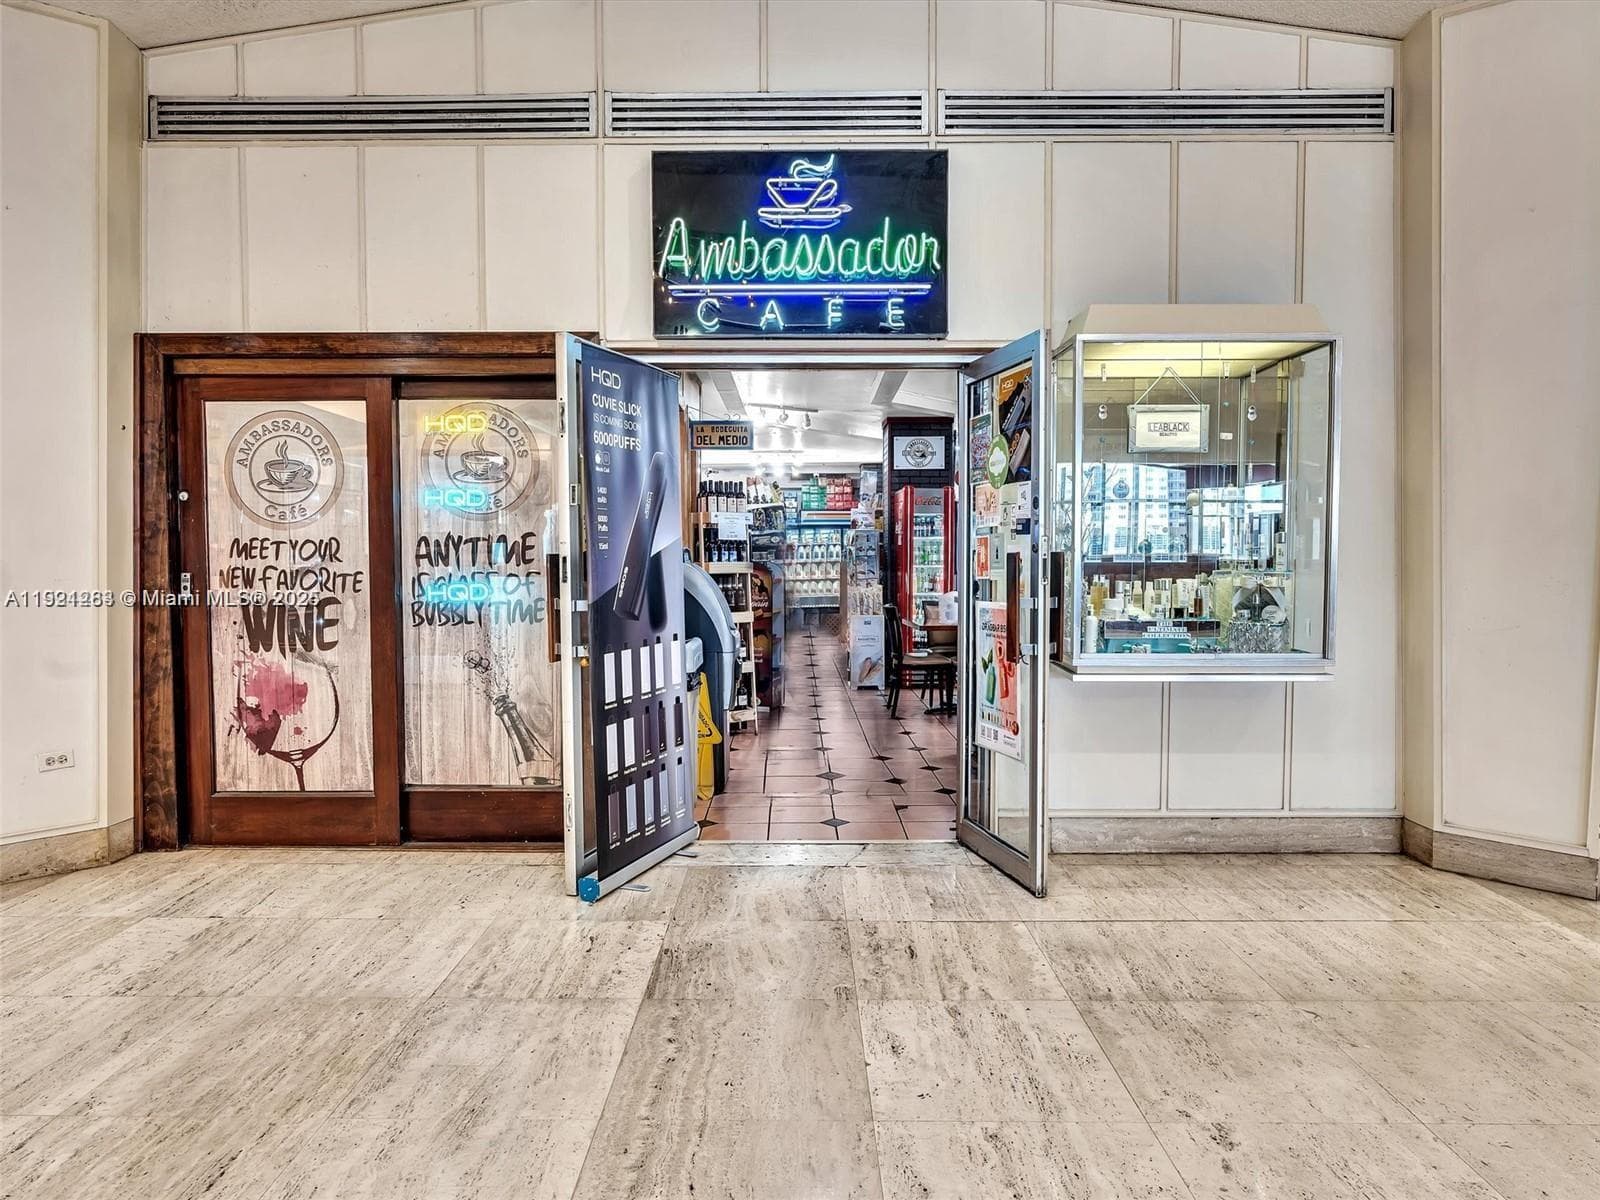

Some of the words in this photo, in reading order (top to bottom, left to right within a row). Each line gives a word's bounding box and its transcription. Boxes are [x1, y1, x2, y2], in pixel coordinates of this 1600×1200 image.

[658, 216, 941, 279] Ambassador
[697, 297, 905, 330] CAFE
[590, 365, 622, 390] HQD
[591, 393, 617, 412] CUVIE
[618, 400, 642, 417] SLICK
[424, 413, 488, 434] HQD
[600, 414, 623, 428] COMING
[695, 425, 705, 433] LA
[236, 419, 333, 469] AMBASSADORS
[593, 430, 642, 452] 6000PUFFS
[696, 435, 715, 446] DEL
[718, 435, 748, 446] MEDIO
[424, 489, 487, 507] HQD
[264, 503, 308, 521] Café
[229, 537, 287, 561] MEET
[289, 536, 343, 565] YOUR
[415, 531, 537, 571] ANYTIME
[218, 565, 256, 589] NEW
[258, 565, 364, 594] FAVORITE
[425, 582, 489, 602] HQD
[502, 571, 541, 598] OF
[411, 600, 485, 628] BUBBLY
[489, 597, 545, 627] TIME
[241, 596, 342, 661] WINE
